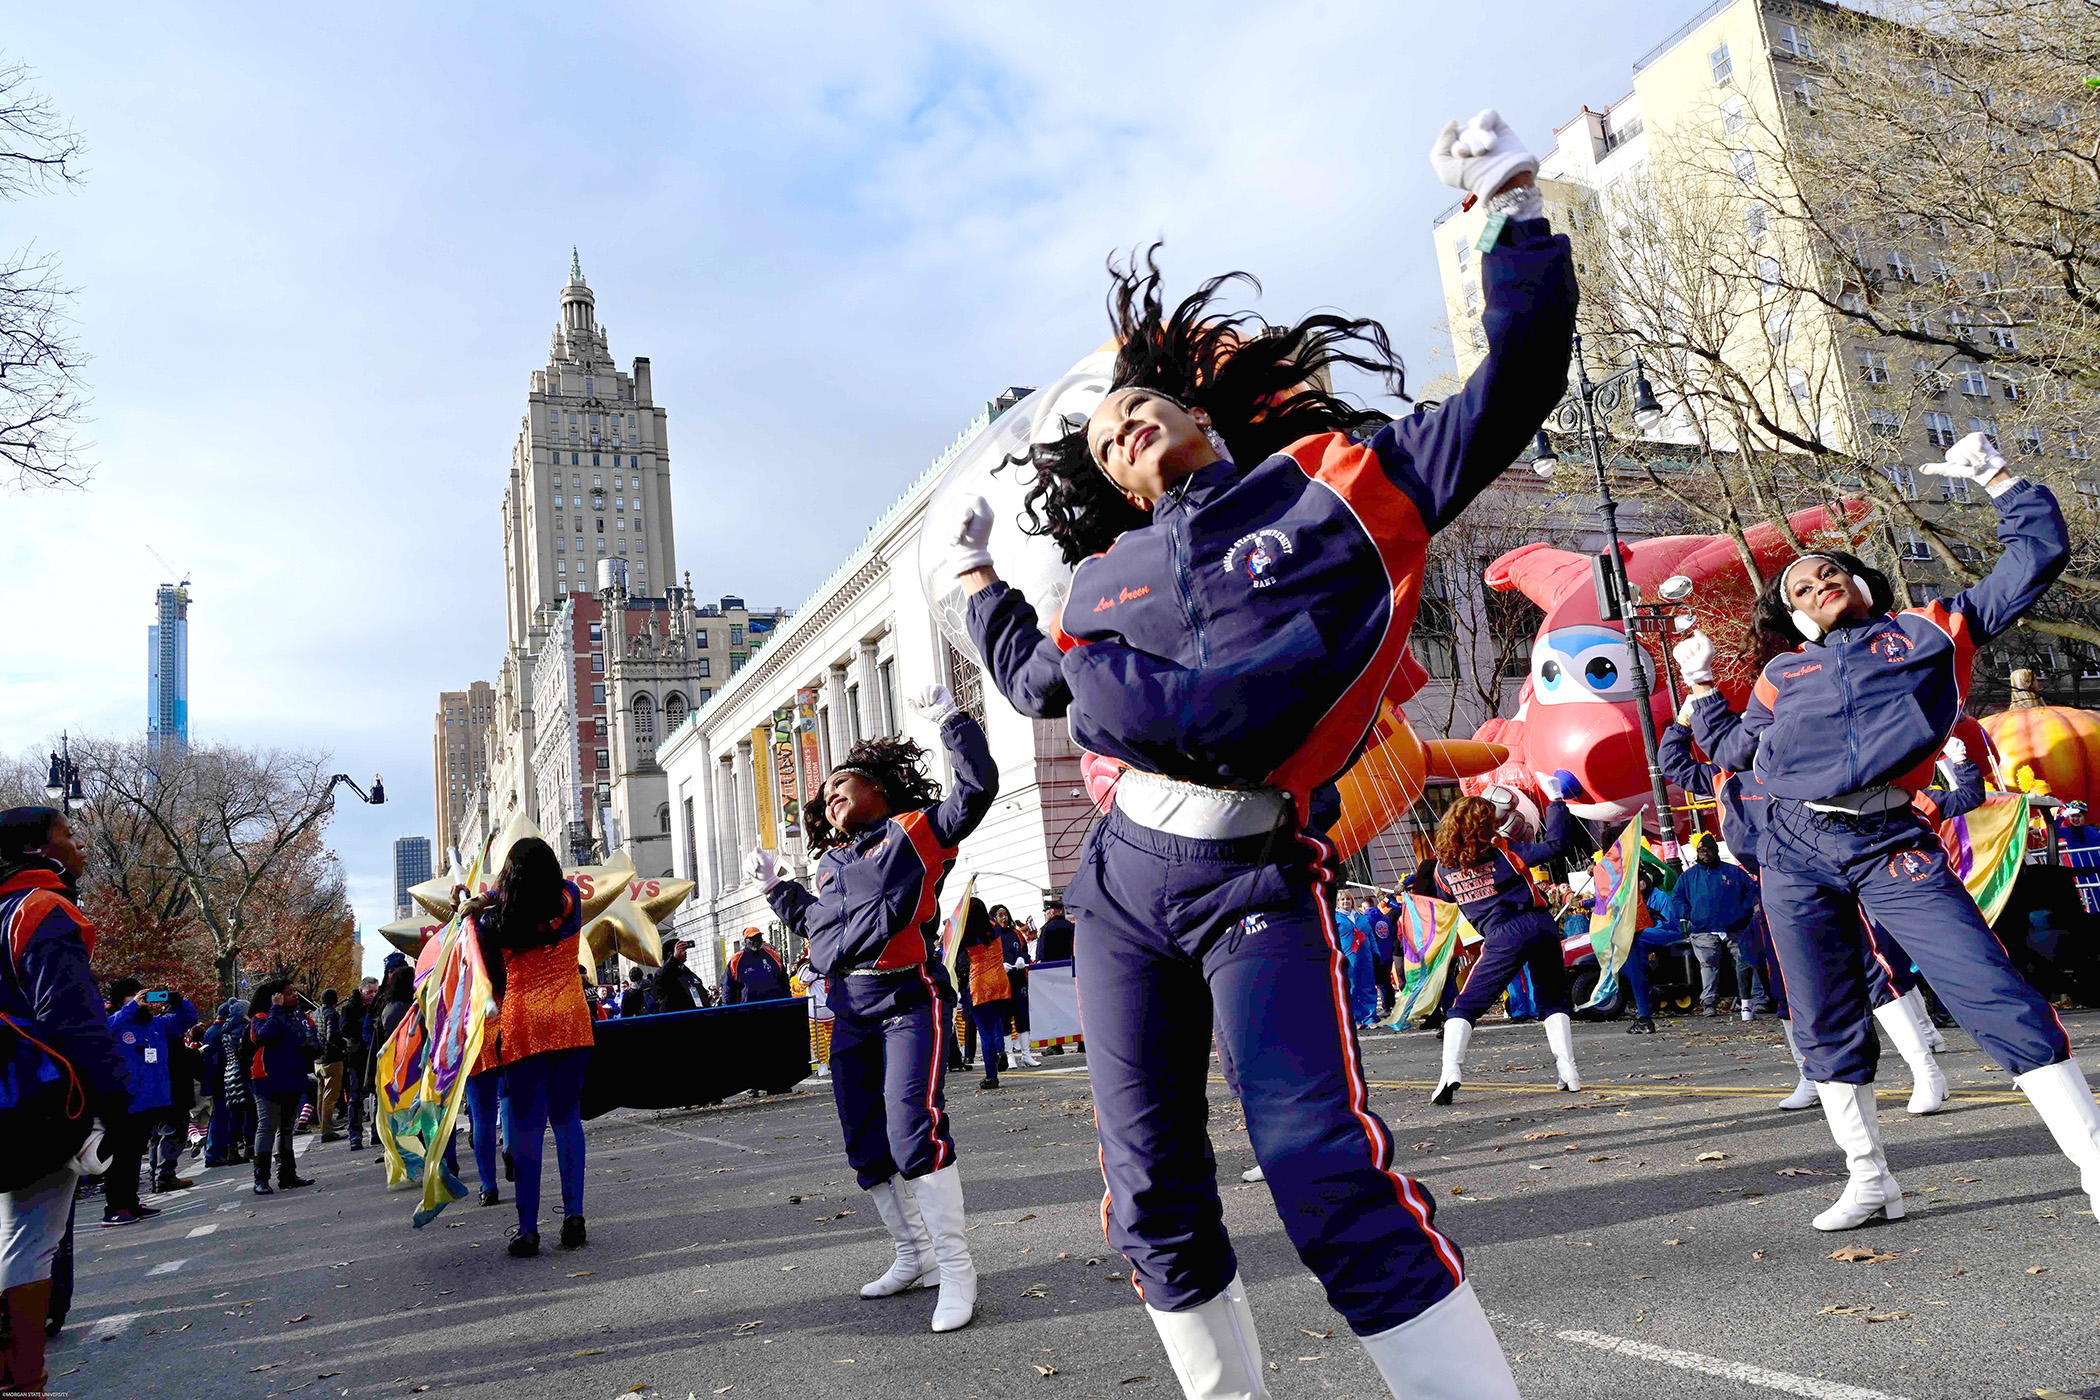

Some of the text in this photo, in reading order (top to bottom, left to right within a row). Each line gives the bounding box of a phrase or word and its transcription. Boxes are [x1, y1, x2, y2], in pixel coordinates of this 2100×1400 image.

[1259, 529, 1293, 554] UNIVERSITY
[1253, 576, 1277, 589] BAND
[1645, 618, 1654, 631] 77
[1657, 618, 1667, 631] ST
[780, 750, 794, 798] TIFFANY
[805, 748, 813, 789] CHILDREN'S
[1450, 873, 1495, 895] MARCHING
[1455, 885, 1498, 905] MACHINE
[1246, 920, 1268, 935] BAND
